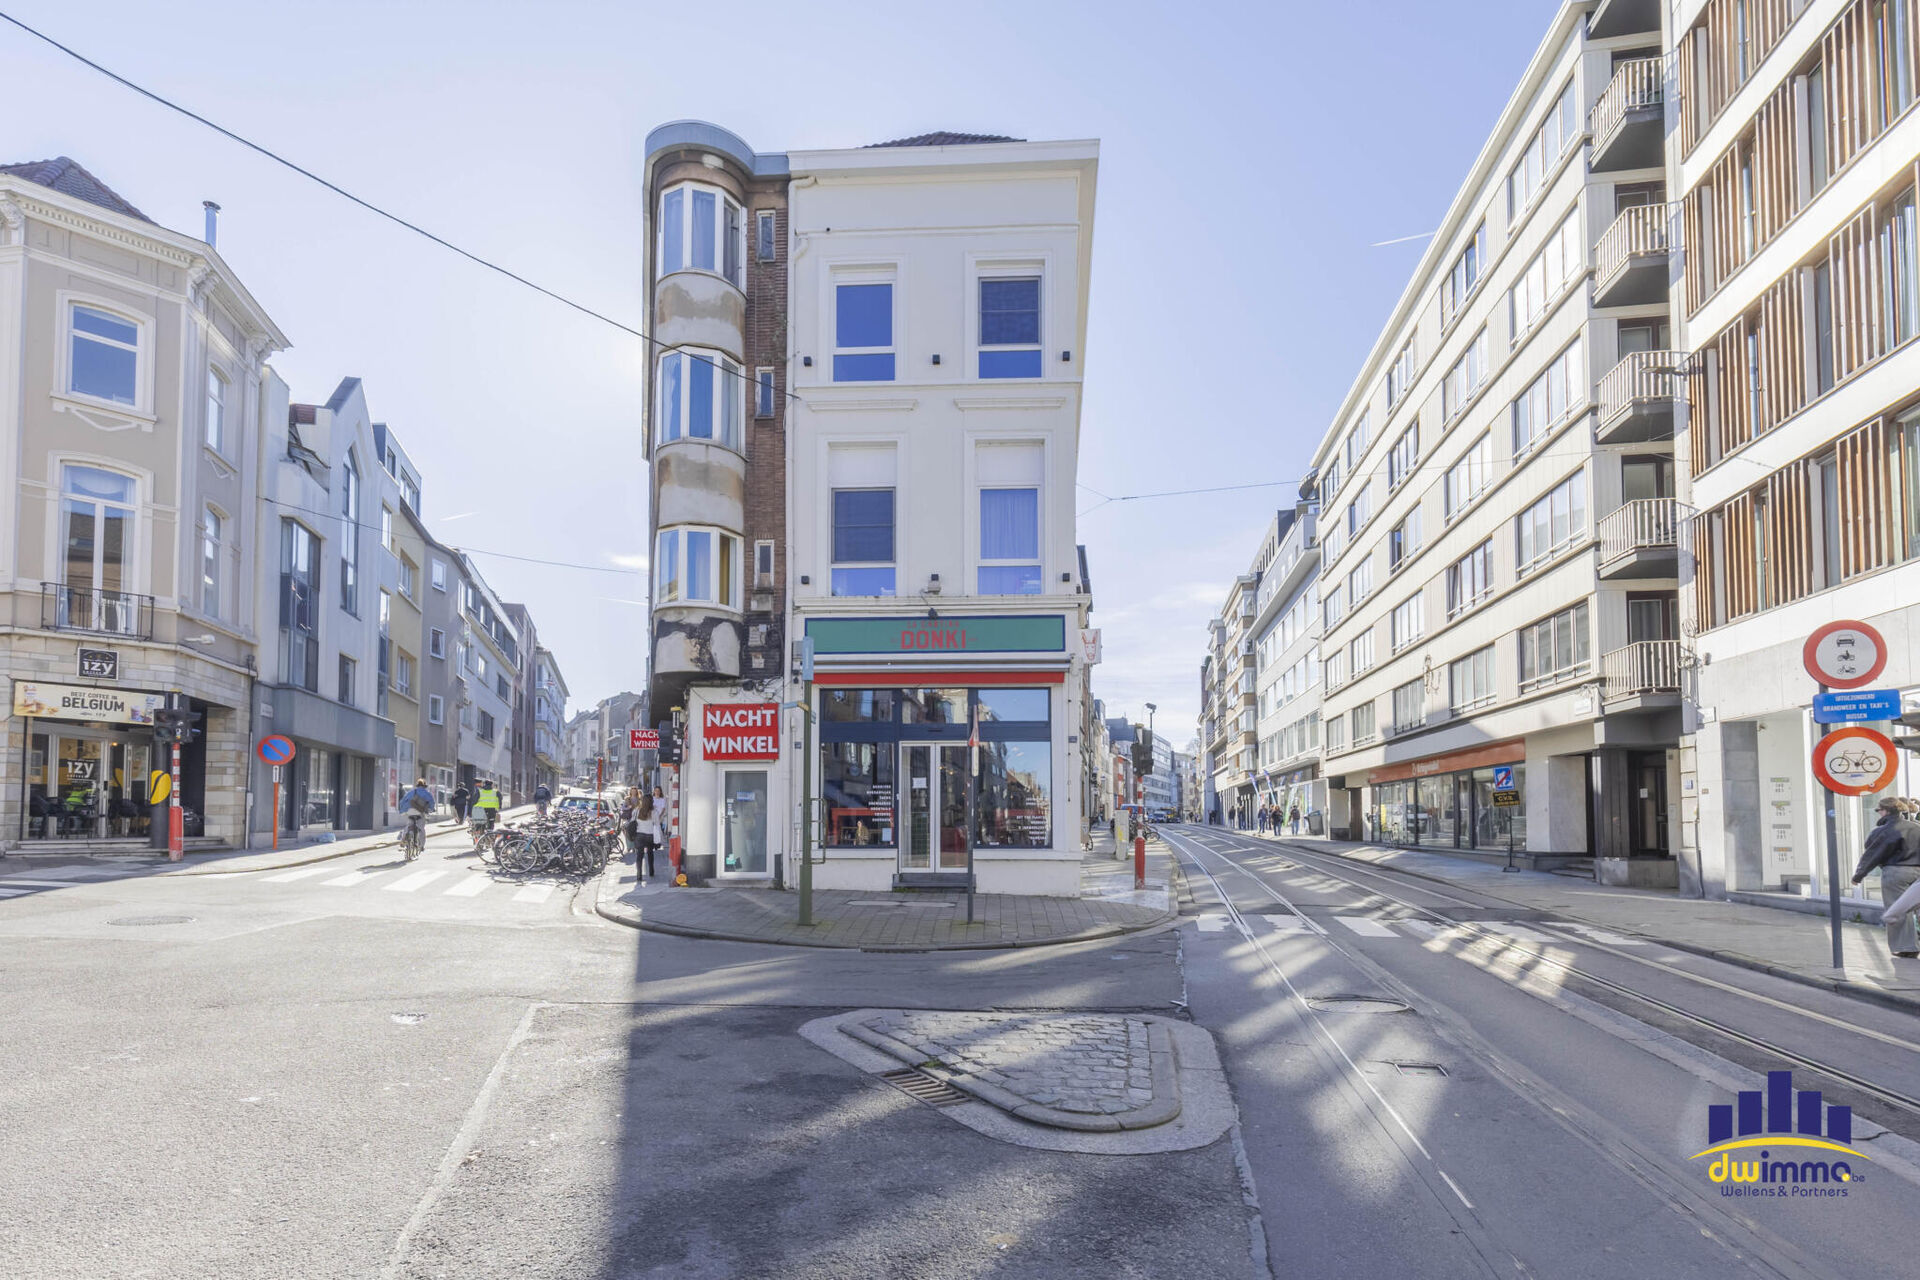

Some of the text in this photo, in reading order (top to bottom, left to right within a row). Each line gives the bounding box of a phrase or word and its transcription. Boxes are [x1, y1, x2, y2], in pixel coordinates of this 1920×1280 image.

[901, 629, 966, 649] DONKI
[62, 696, 124, 712] BELGIUM
[87, 692, 109, 700] COFFEE
[706, 709, 776, 728] NACHT
[635, 730, 660, 739] NACH
[634, 740, 660, 748] WINK
[703, 735, 778, 754] WINKEL
